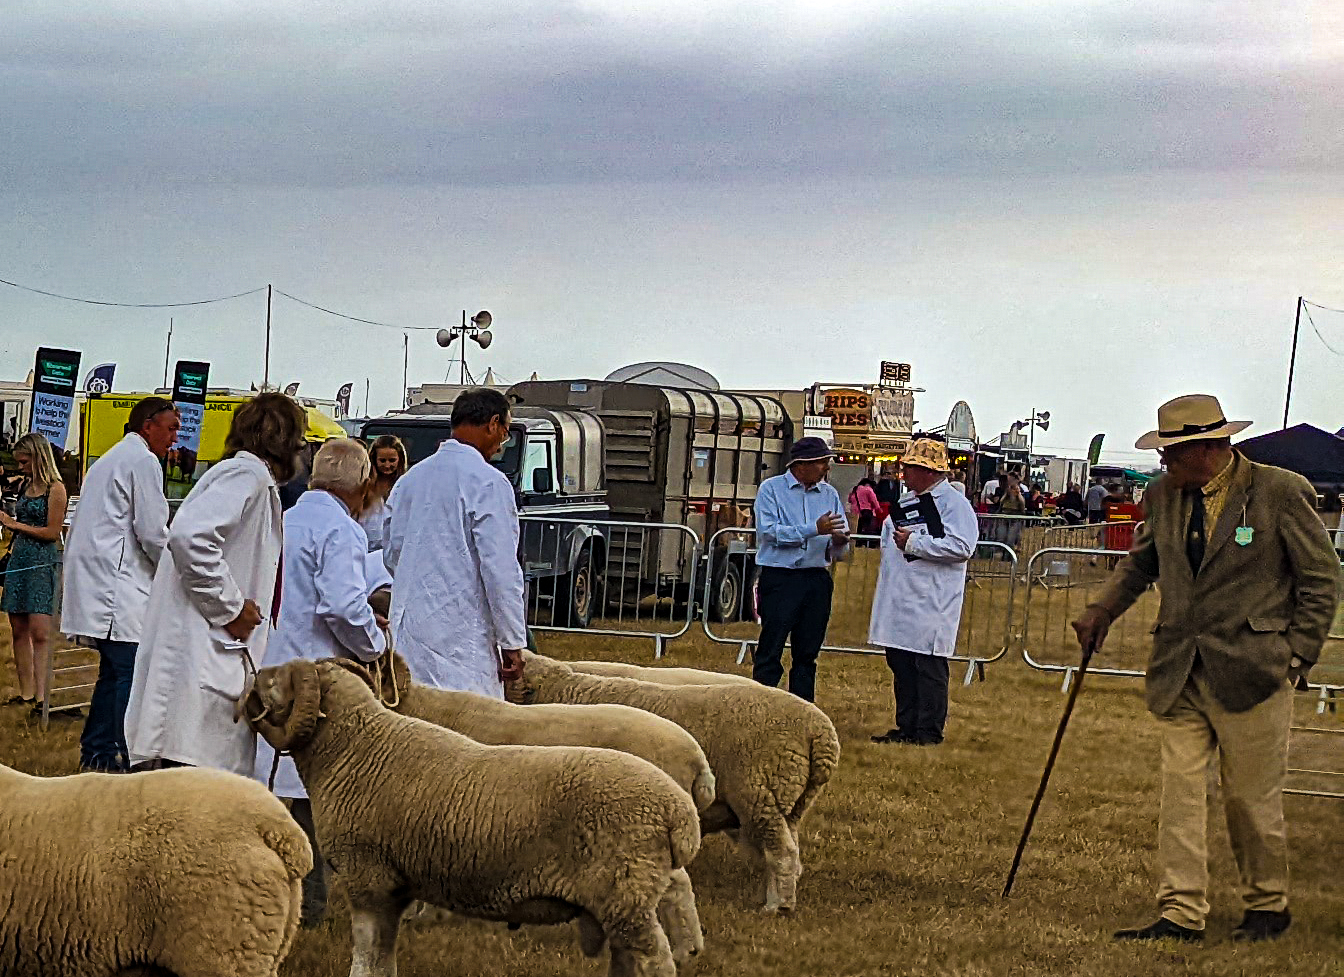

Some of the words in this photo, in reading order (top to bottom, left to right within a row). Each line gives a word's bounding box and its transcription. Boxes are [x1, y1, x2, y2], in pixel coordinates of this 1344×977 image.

[38, 396, 69, 411] Working
[825, 395, 868, 409] HIPS
[41, 408, 57, 418] help
[831, 413, 867, 426] RIES
